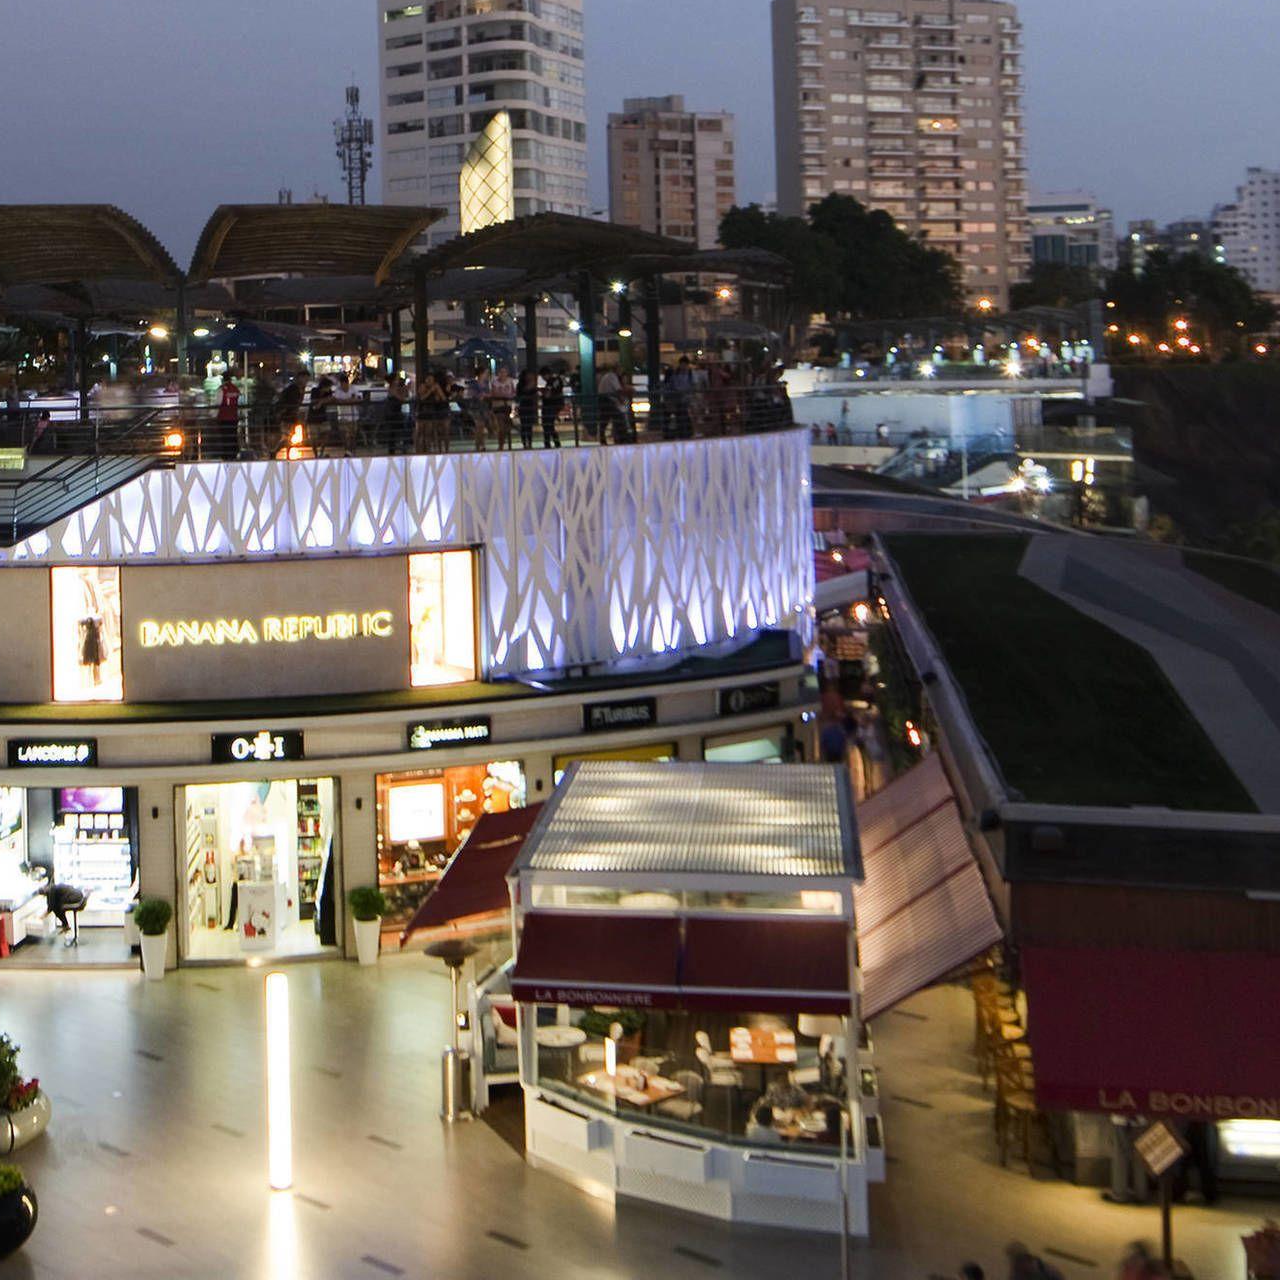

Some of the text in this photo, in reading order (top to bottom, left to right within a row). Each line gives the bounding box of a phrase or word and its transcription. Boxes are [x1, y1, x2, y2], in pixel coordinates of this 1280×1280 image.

[139, 610, 393, 648] BANANA REPUBLIC
[1099, 1090, 1136, 1110] LA
